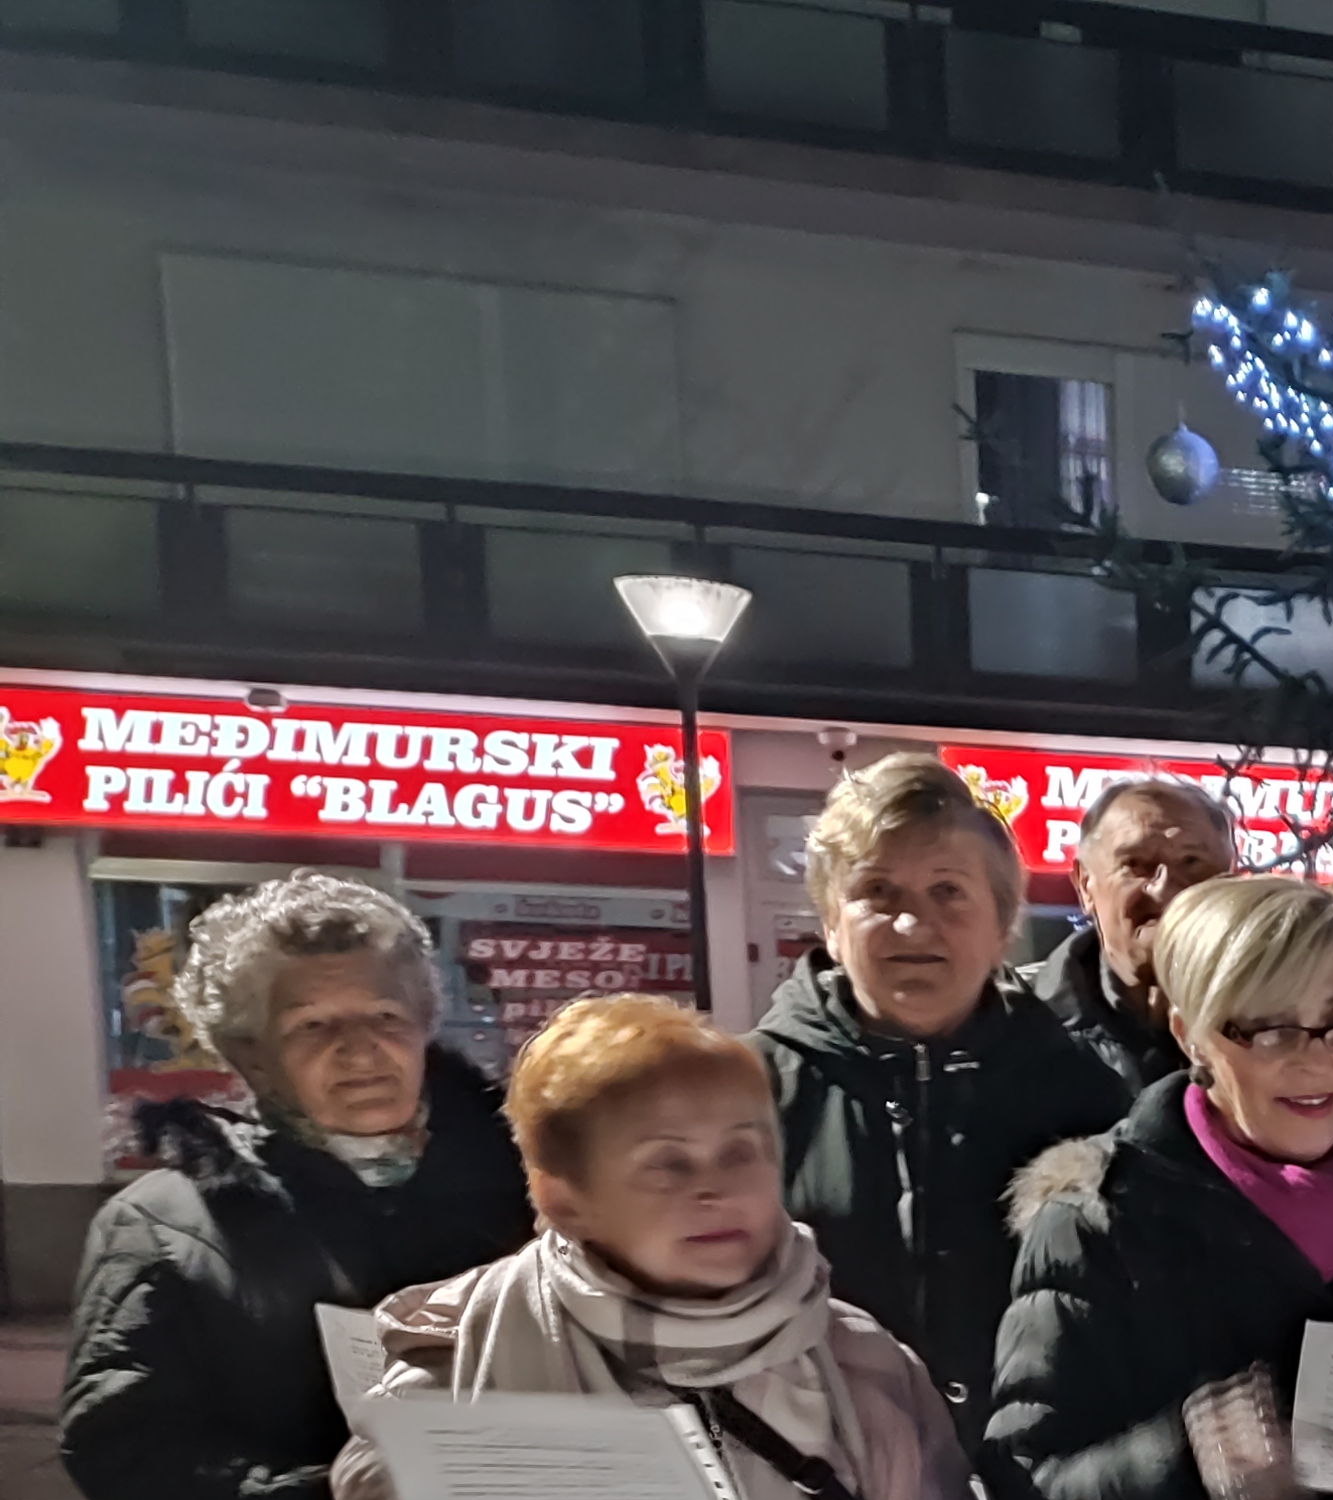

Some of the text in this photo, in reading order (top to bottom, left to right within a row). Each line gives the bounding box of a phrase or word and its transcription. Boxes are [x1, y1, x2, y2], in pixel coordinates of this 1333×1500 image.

[77, 706, 621, 781] MEĐIMURSKI
[82, 758, 270, 820] PILIĆI
[467, 934, 646, 963] SVJEŽE
[488, 968, 626, 989] MESO
